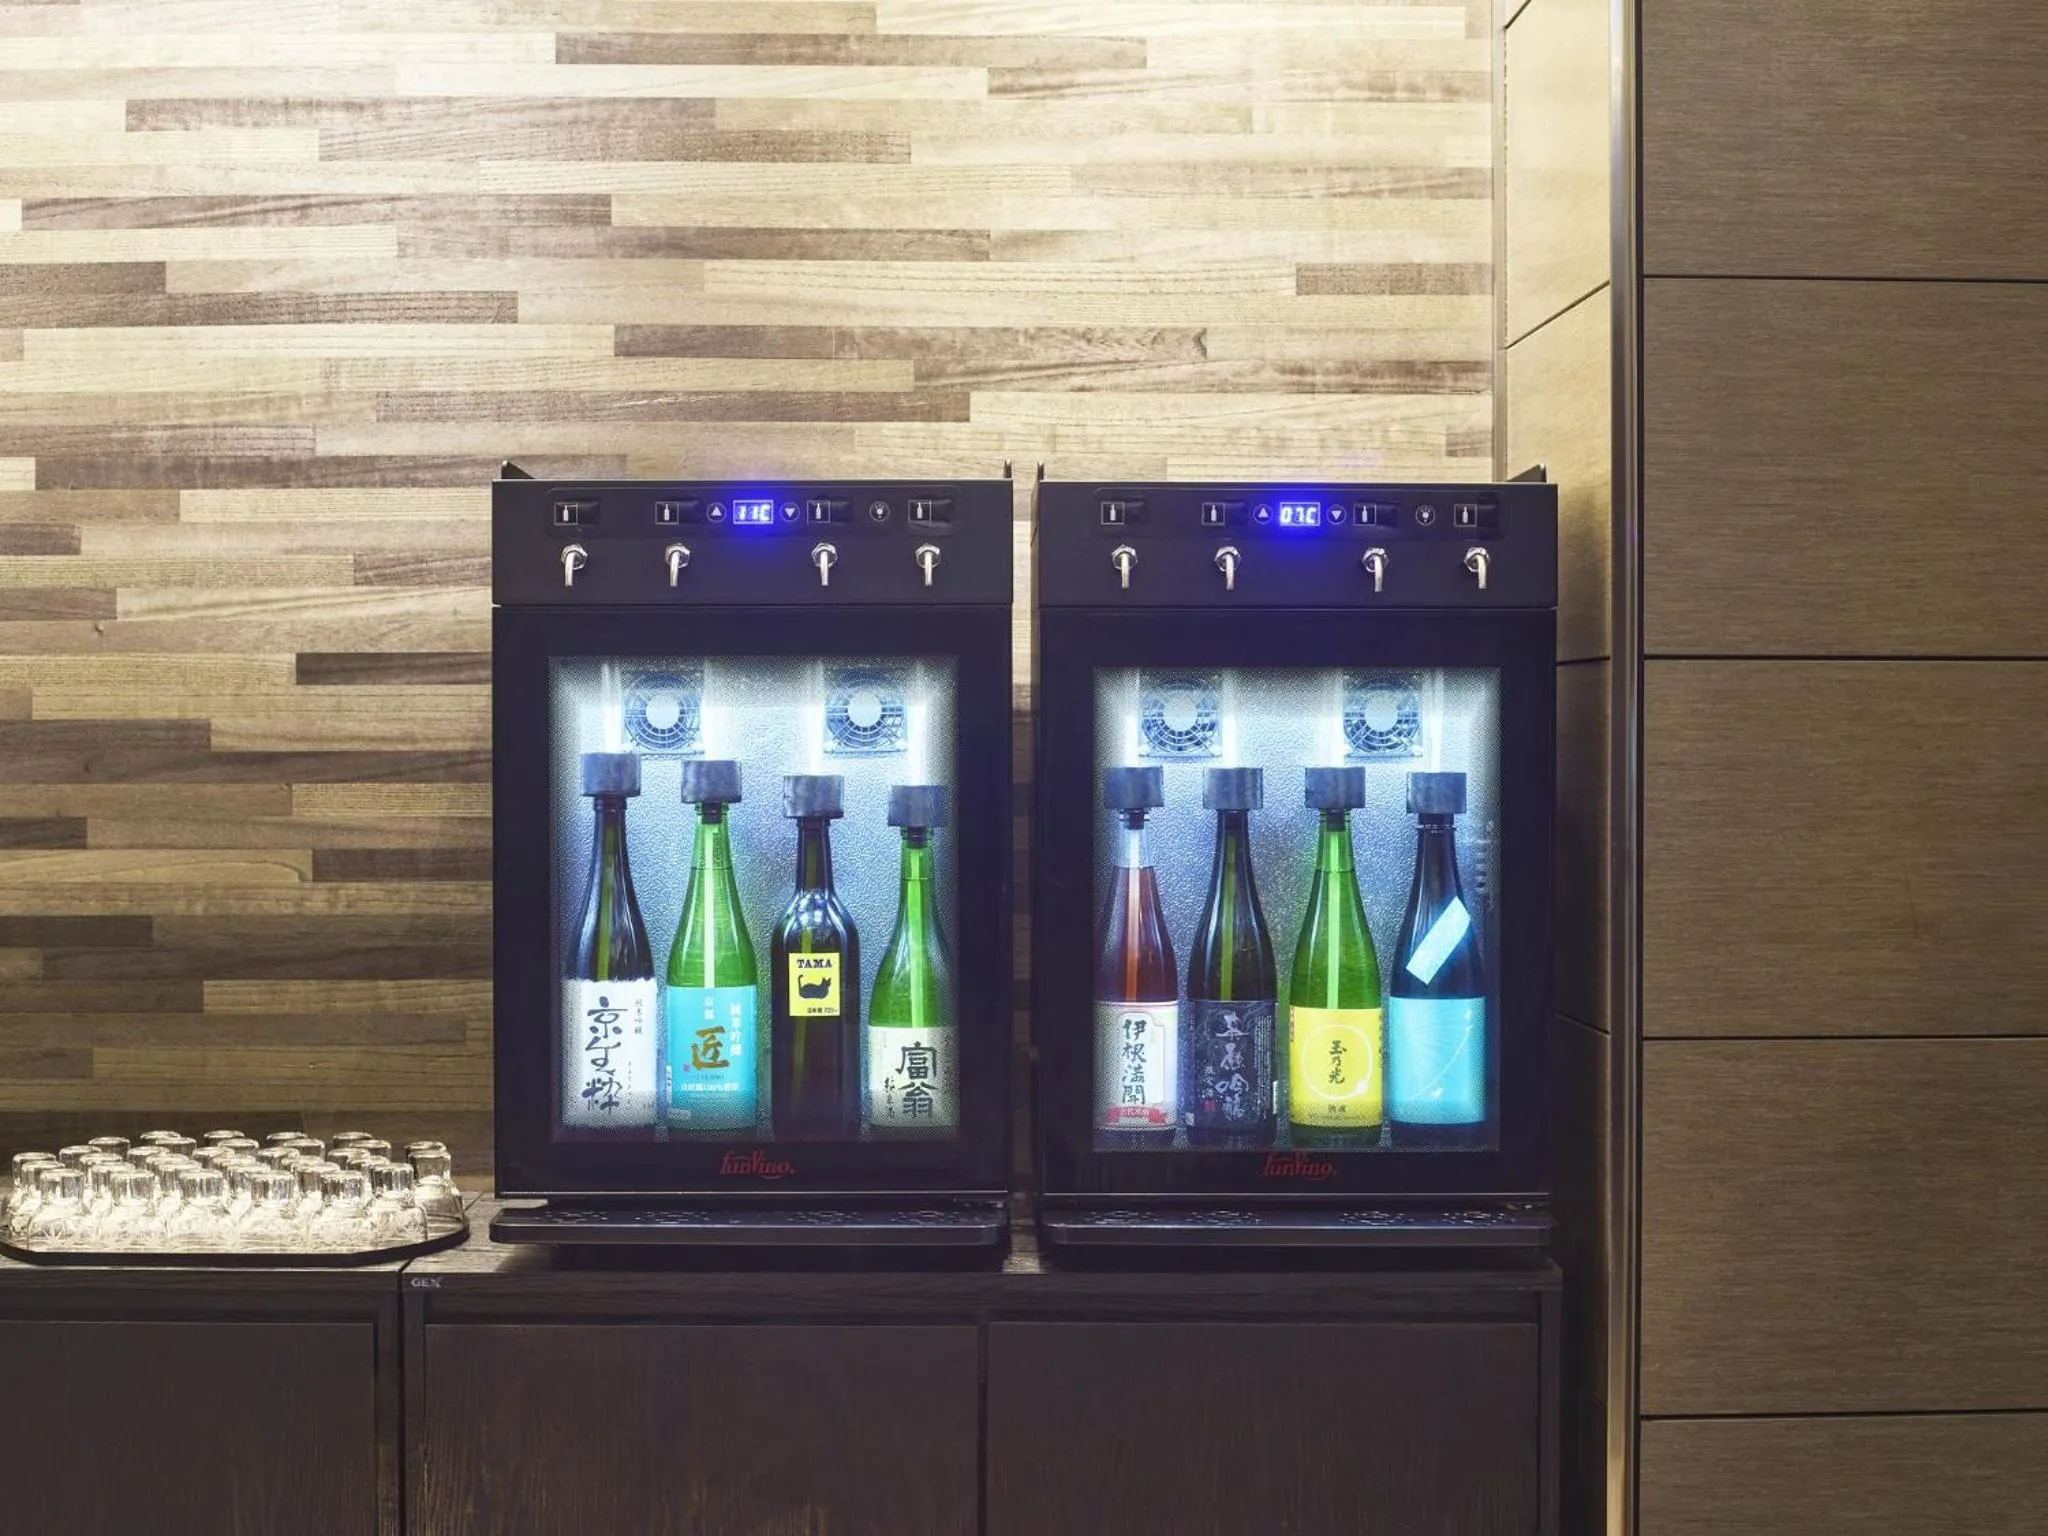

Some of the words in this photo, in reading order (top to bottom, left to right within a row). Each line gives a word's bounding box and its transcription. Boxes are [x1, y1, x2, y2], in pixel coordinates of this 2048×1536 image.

[797, 959, 832, 969] TAMA
[691, 1025, 730, 1069] 匠
[1122, 1019, 1147, 1104] 伊根満開
[1328, 1040, 1347, 1084] 玉乃光
[896, 1041, 939, 1119] 富翁
